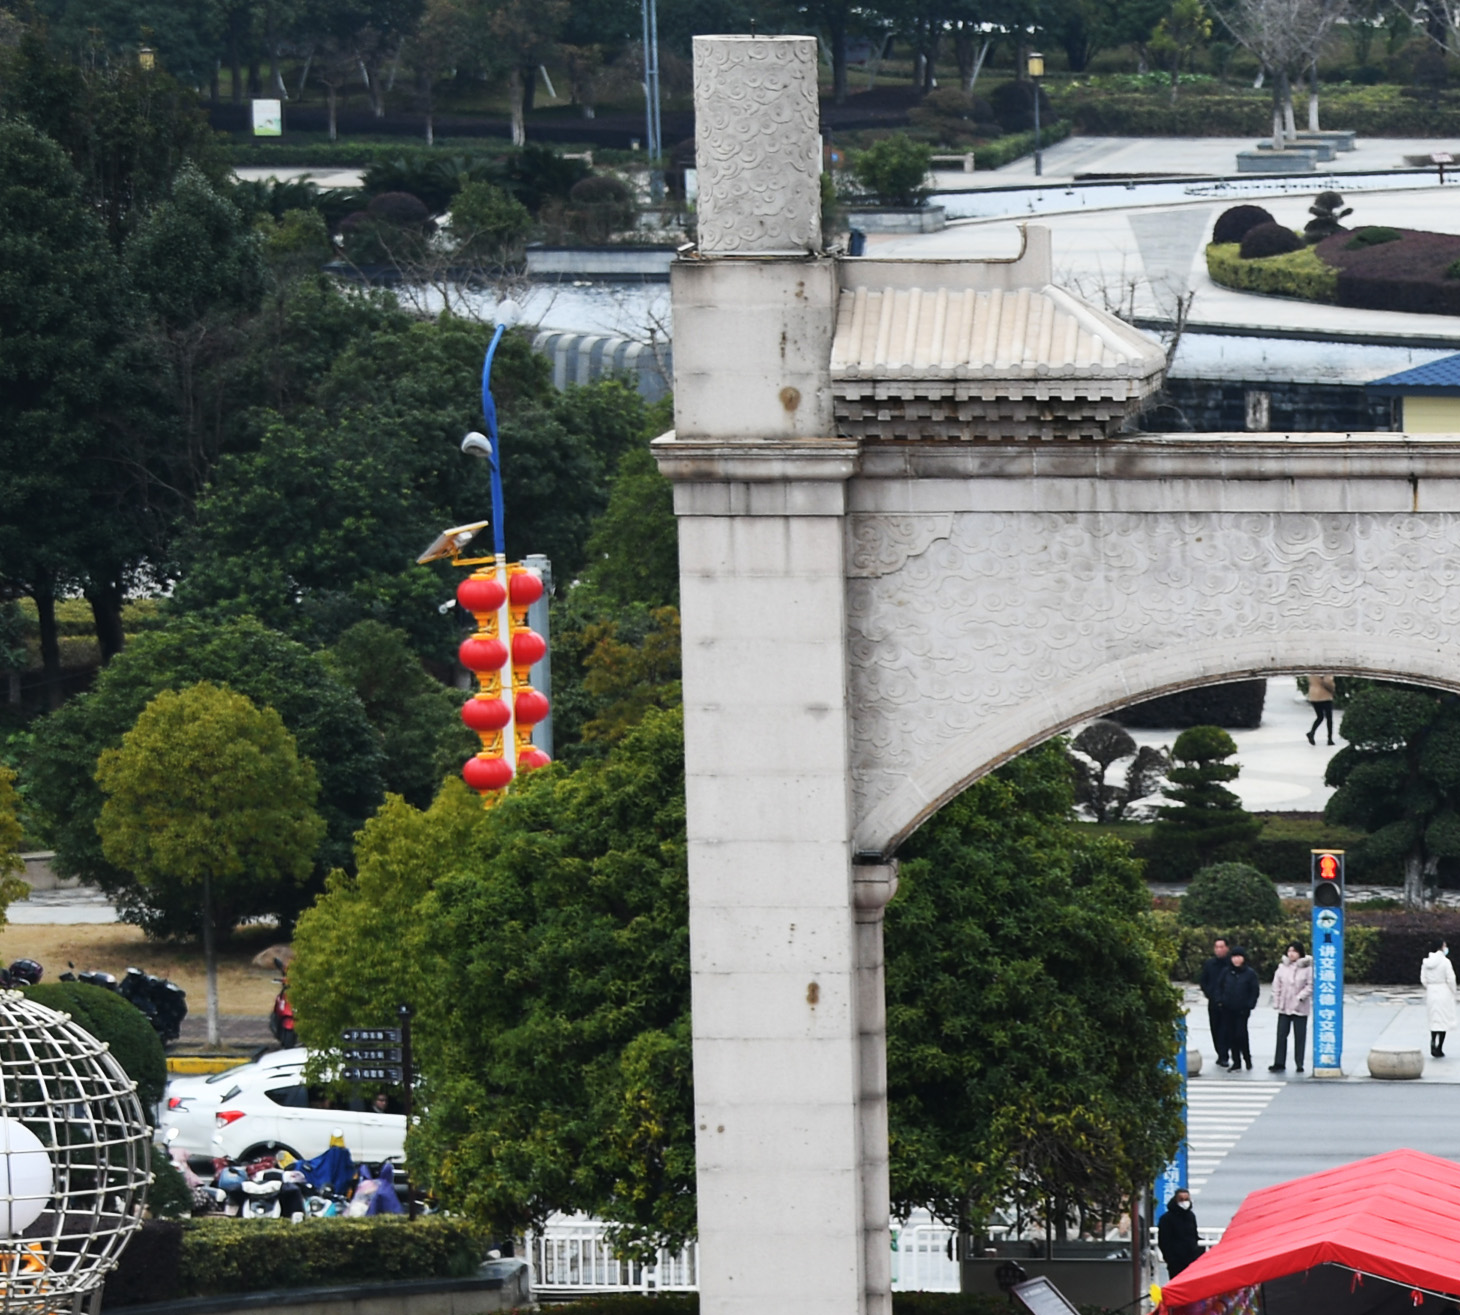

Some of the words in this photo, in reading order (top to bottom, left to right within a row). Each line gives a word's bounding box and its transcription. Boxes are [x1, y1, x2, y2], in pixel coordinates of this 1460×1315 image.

[1318, 945, 1337, 1006] 讲交通公德
